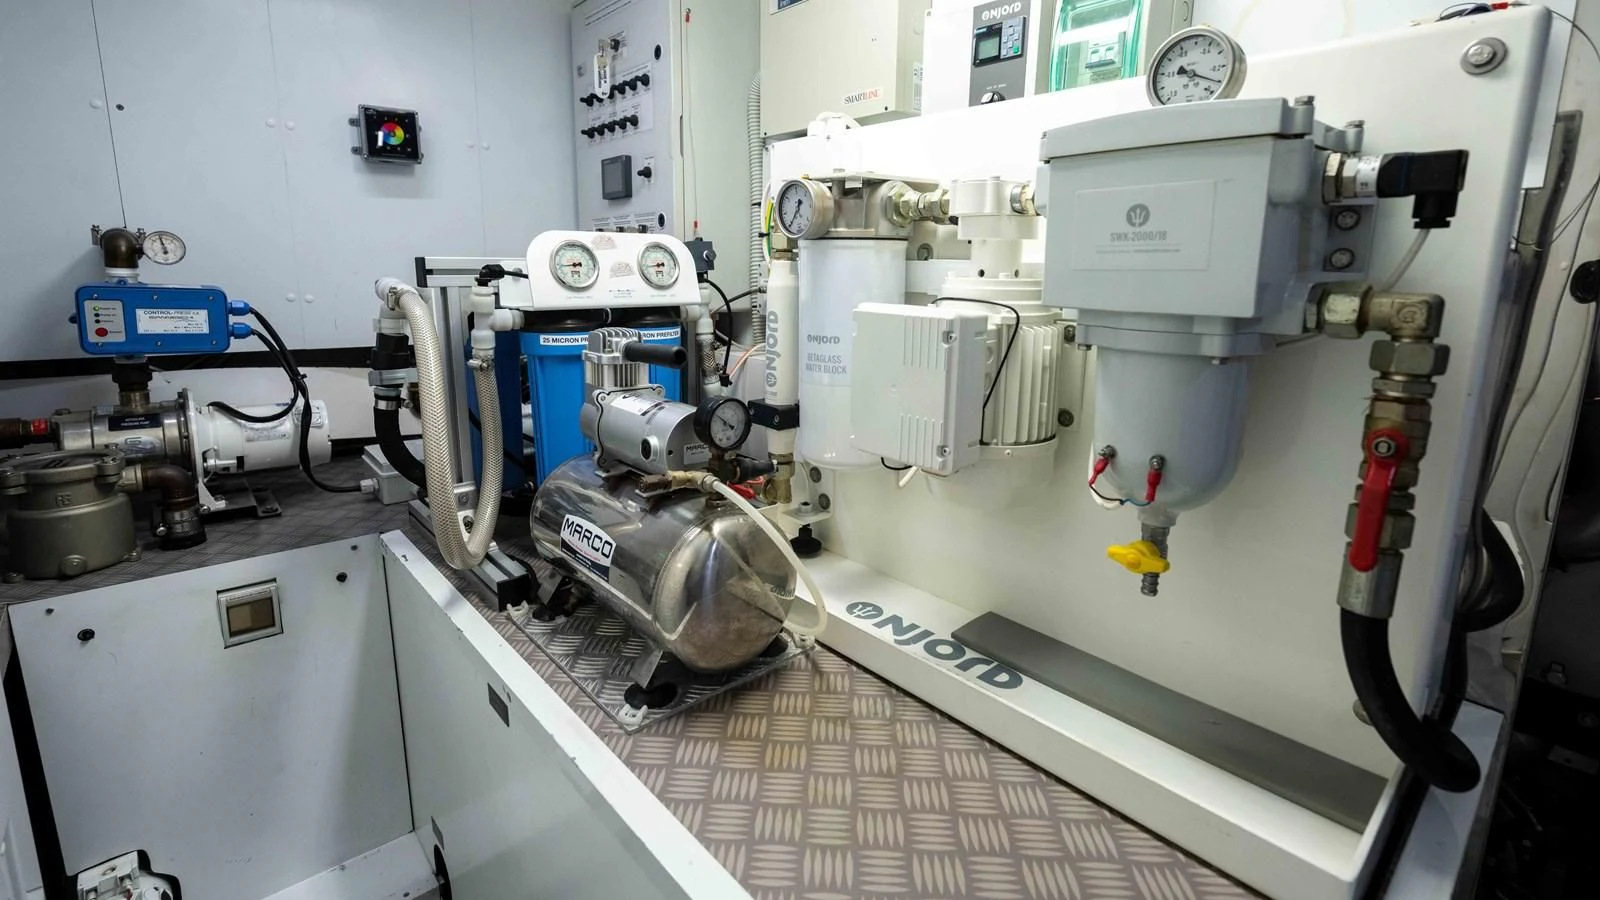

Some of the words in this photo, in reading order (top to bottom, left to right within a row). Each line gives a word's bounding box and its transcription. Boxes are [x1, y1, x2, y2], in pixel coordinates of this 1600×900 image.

[1110, 230, 1168, 242] SWK-2000/18
[655, 330, 680, 338] PREFILTER
[551, 336, 580, 344] MICRON
[807, 353, 842, 364] BETAGLASS
[805, 363, 822, 373] WATER
[823, 364, 847, 374] BLOCK
[563, 517, 613, 559] MARCO
